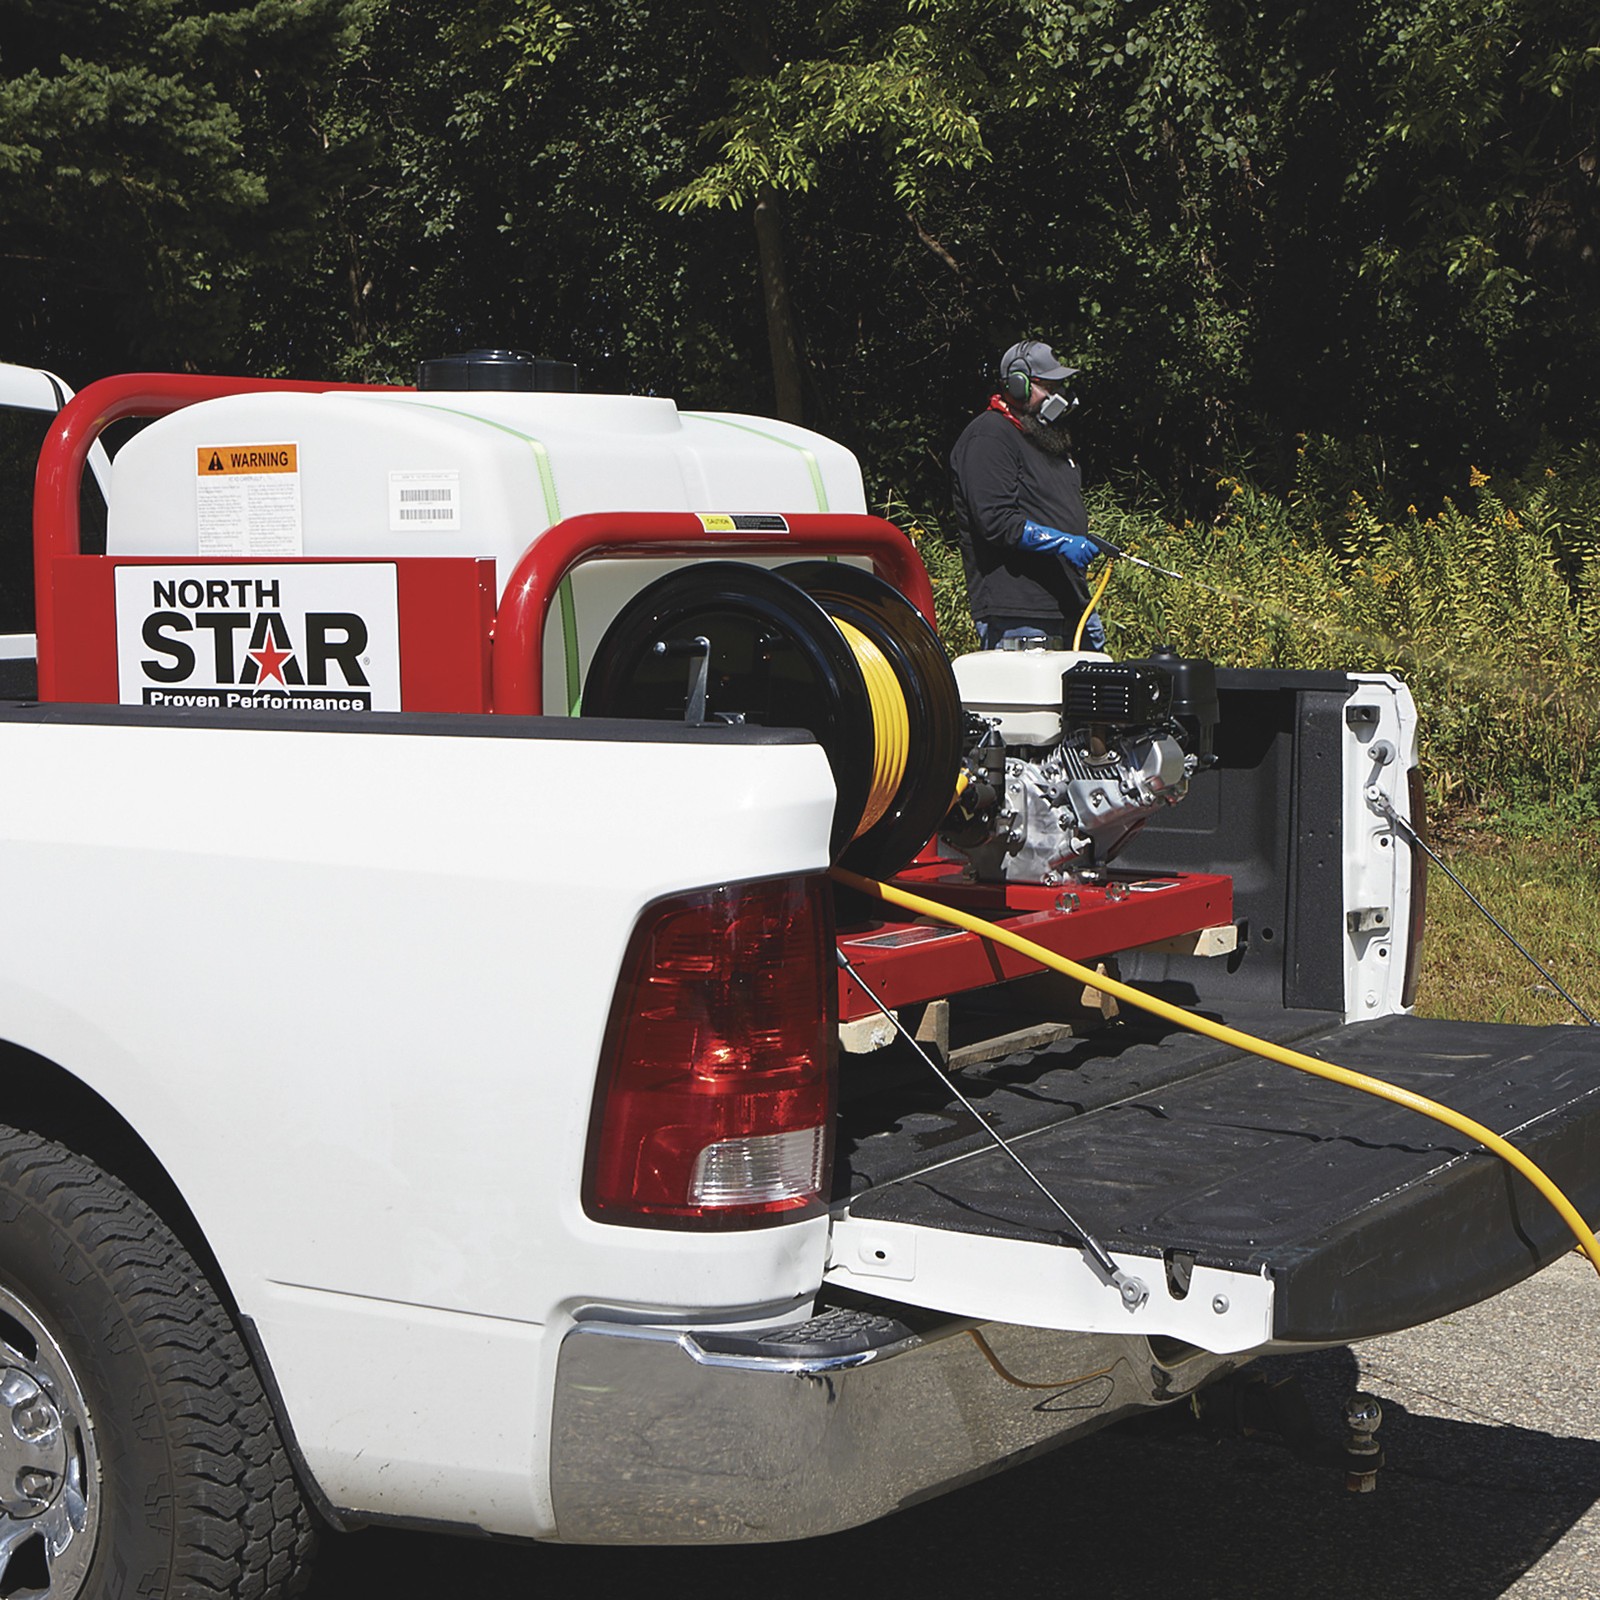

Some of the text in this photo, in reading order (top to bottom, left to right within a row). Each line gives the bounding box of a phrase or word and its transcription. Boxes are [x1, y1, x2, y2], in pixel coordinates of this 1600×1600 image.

[230, 451, 289, 468] WARNING
[153, 579, 280, 608] NORTH
[140, 611, 370, 687] STAR
[150, 691, 364, 711] Proven Performance
